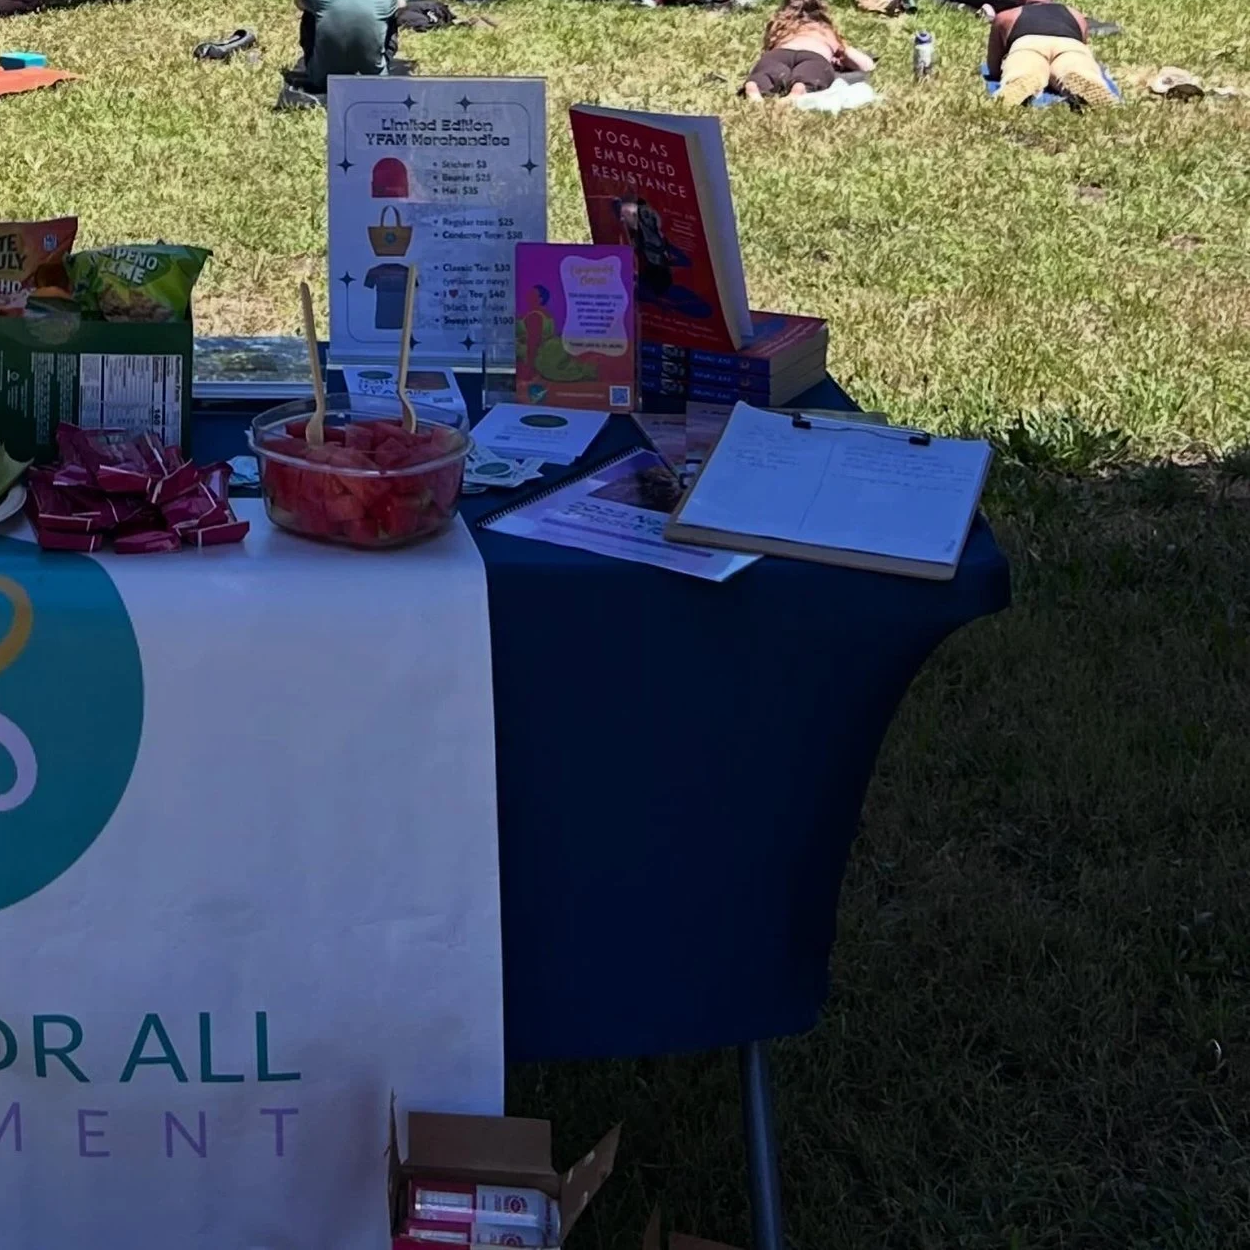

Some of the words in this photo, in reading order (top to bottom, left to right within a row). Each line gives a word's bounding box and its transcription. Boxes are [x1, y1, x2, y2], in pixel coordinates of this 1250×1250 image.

[365, 133, 407, 146] YFAM
[381, 118, 437, 132] Limited
[442, 118, 493, 132] Edition
[594, 128, 642, 150] YOGA
[650, 142, 668, 158] AS
[594, 146, 676, 177] EMBODIED
[591, 163, 687, 198] RESISTANCE
[118, 1010, 302, 1084] ALL
